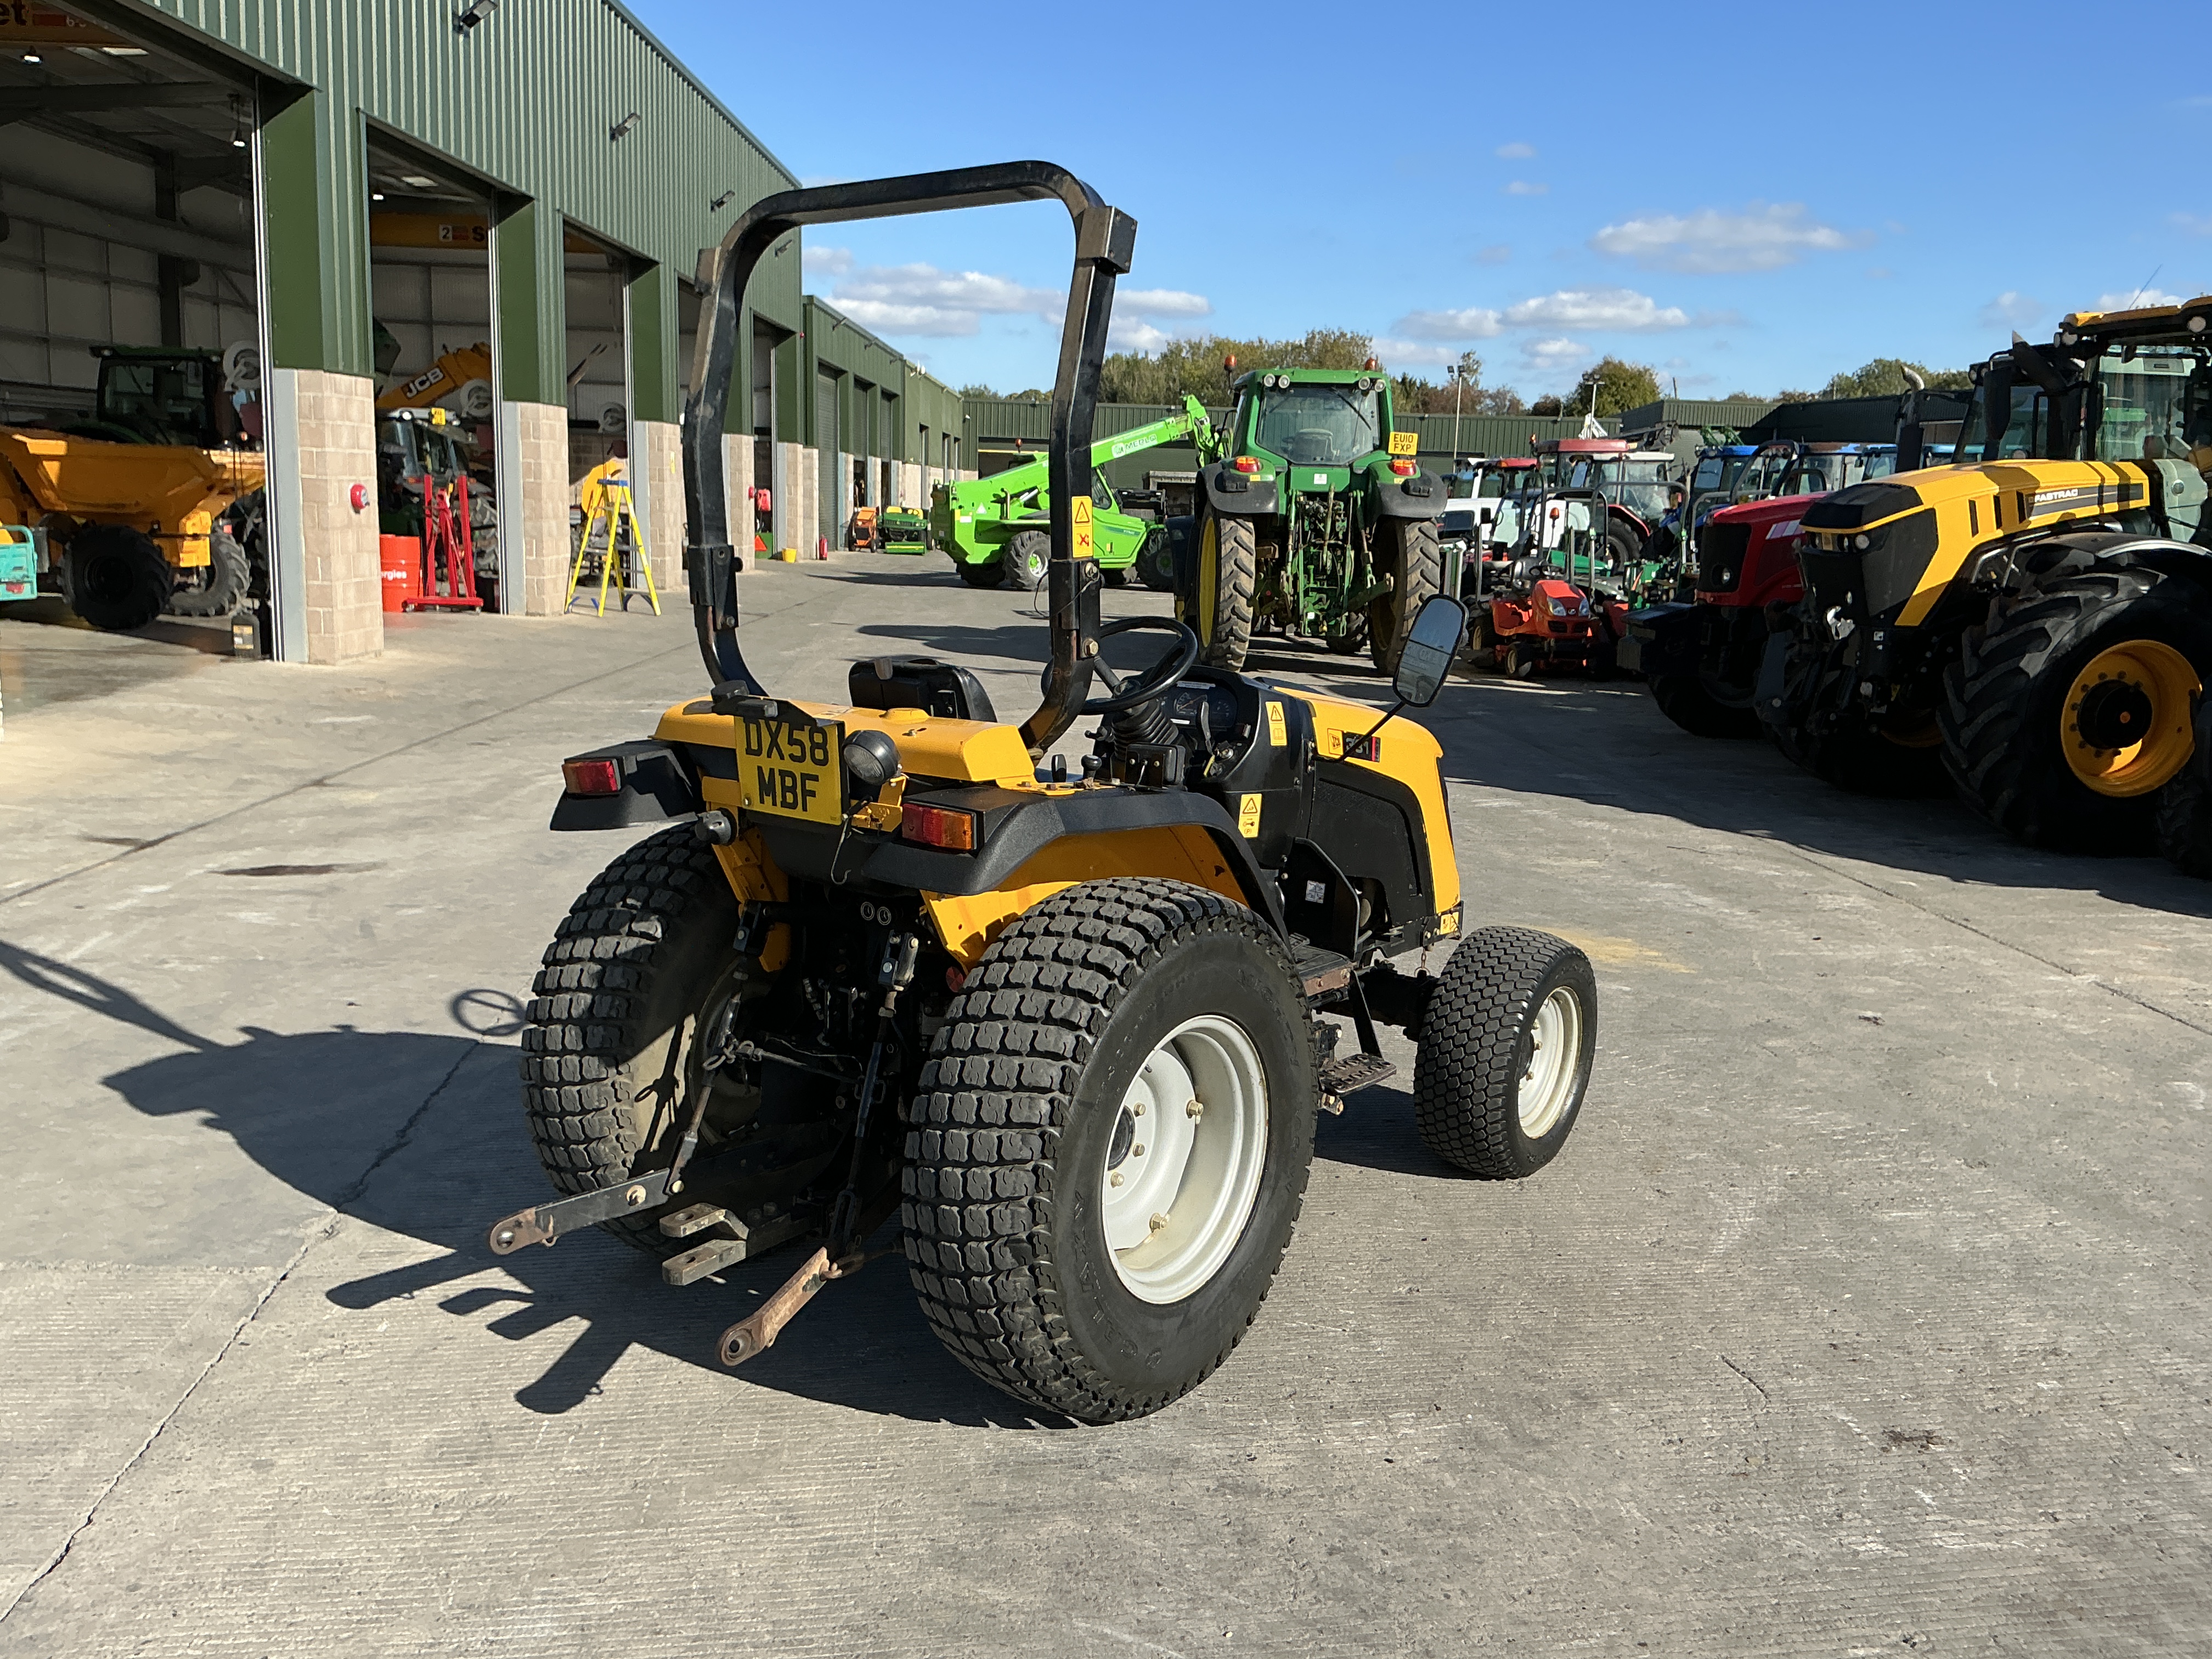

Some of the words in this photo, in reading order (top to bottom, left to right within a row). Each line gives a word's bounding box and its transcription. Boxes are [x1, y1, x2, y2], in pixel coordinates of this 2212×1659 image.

[406, 366, 444, 398] JCB
[1125, 435, 1156, 450] MERLO
[1393, 433, 1414, 443] EU10
[1393, 443, 1412, 453] FXP
[2034, 489, 2078, 503] FASTRAC
[745, 719, 829, 766] DX58
[757, 765, 819, 812] MBF
